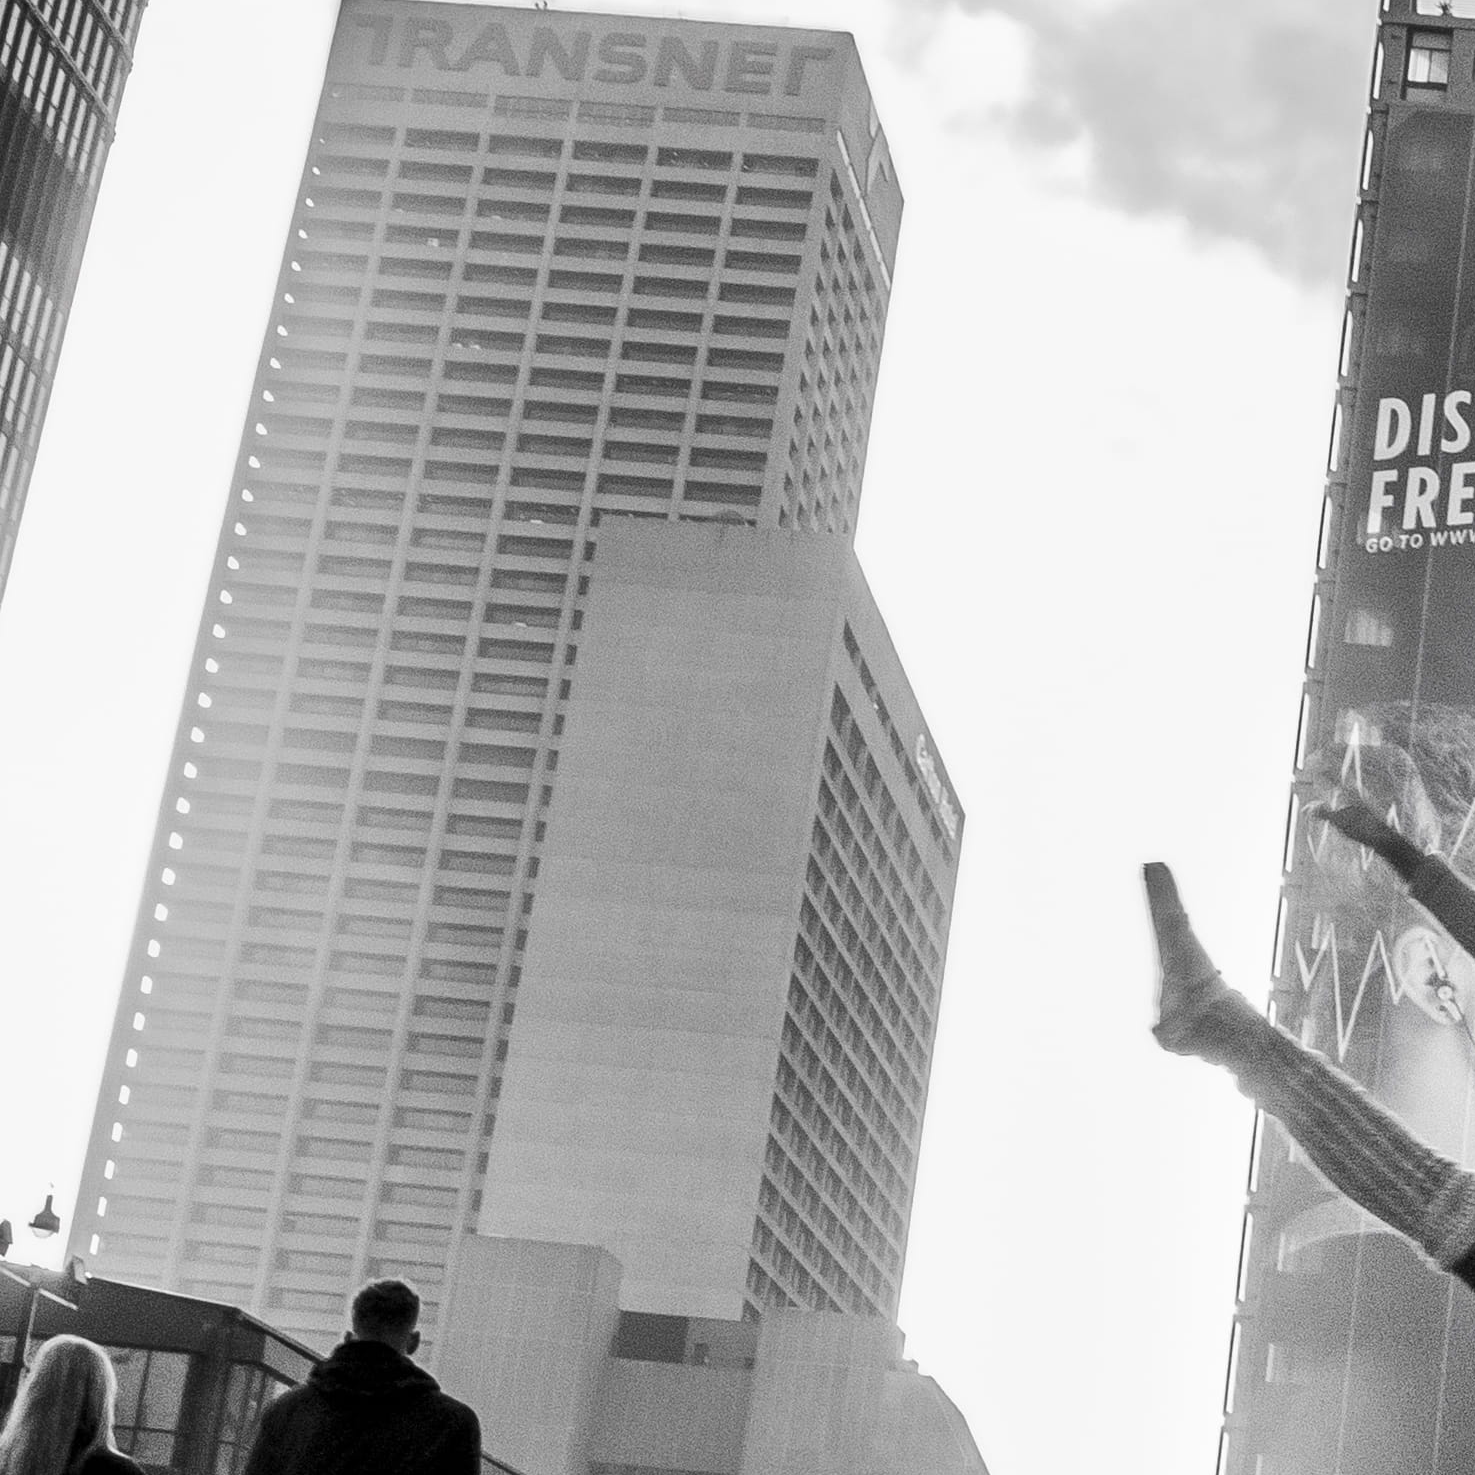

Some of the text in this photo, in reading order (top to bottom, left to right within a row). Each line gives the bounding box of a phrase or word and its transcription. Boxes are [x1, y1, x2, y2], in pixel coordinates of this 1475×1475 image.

[354, 13, 836, 98] TRANSNET
[1365, 536, 1393, 553] GO
[1400, 533, 1423, 549] TO
